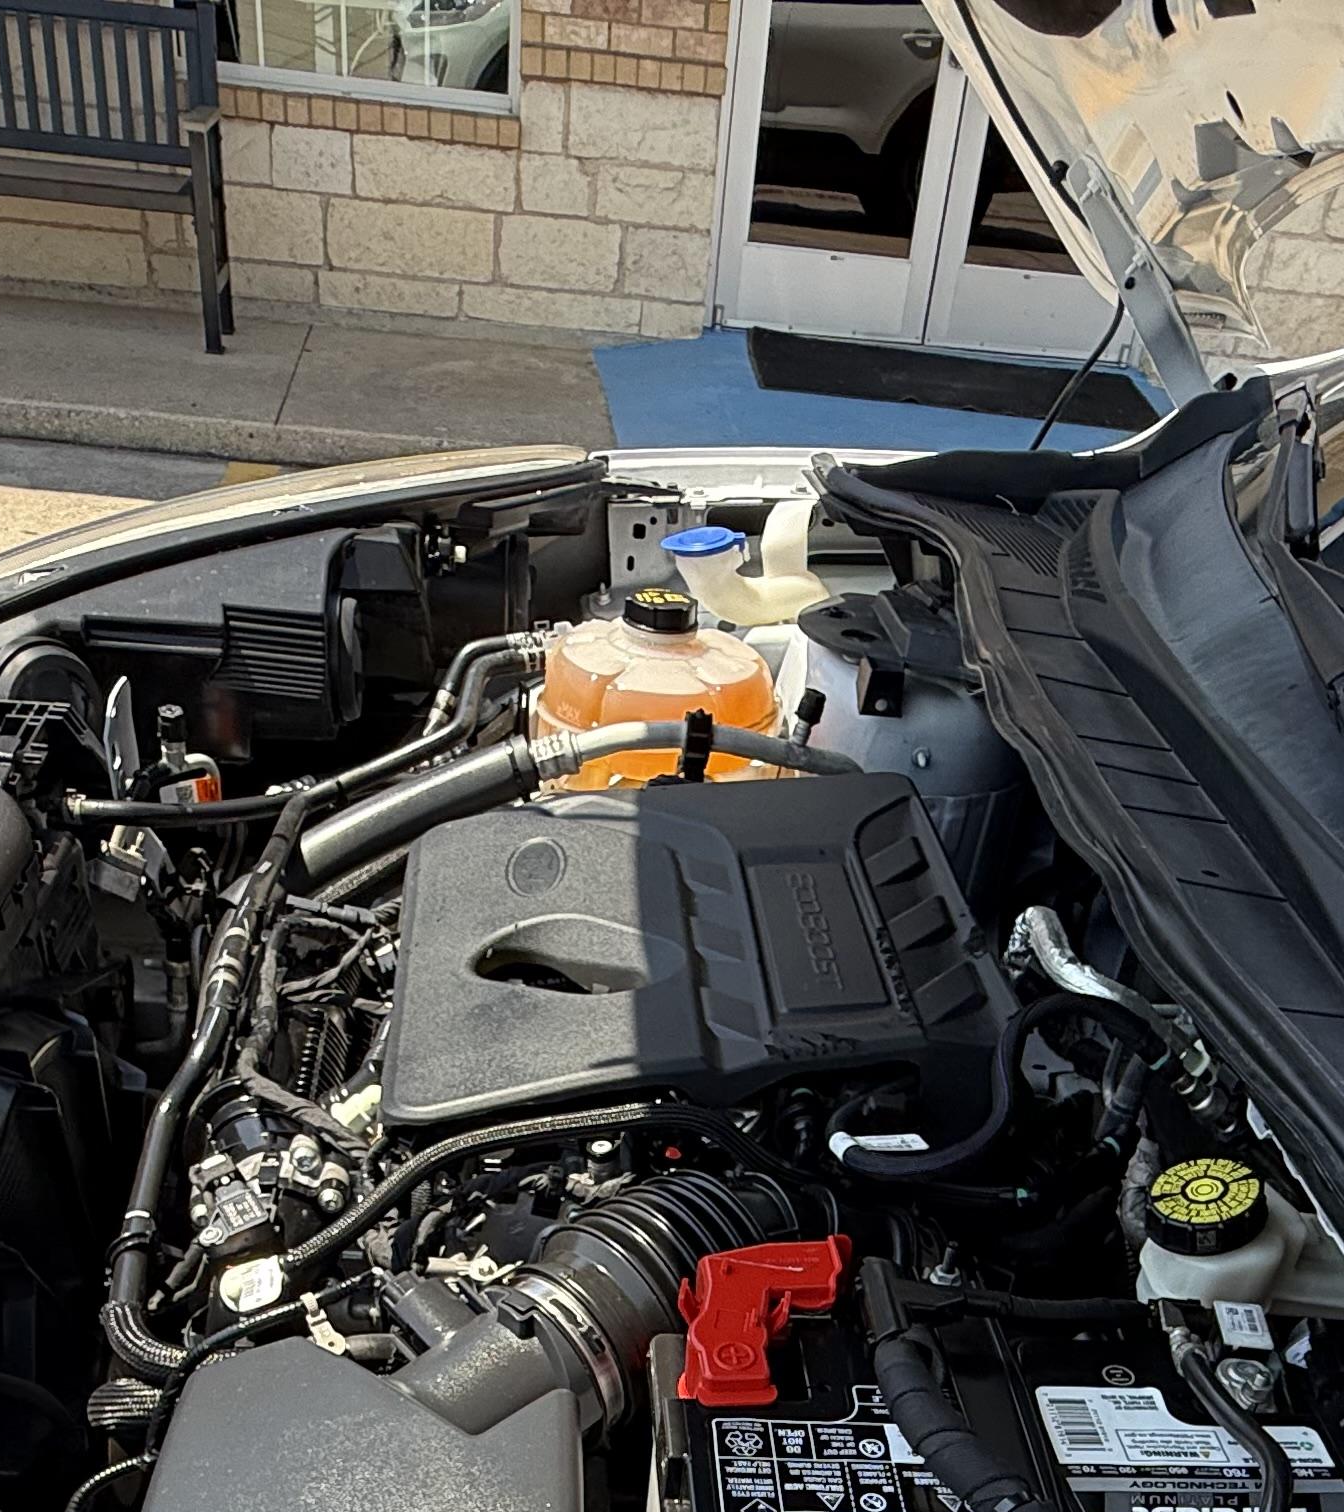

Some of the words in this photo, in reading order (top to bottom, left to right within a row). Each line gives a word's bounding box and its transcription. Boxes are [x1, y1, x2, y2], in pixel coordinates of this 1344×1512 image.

[774, 1428, 805, 1437] OPEN.
[781, 1437, 804, 1445] NOT
[785, 1445, 802, 1454] DO
[839, 1448, 857, 1456] KEEP
[1139, 1449, 1199, 1459] WARNING:
[1082, 1465, 1096, 1474] 70
[1222, 1467, 1250, 1478] 760
[1128, 1480, 1250, 1490] TECHNOLOGY
[1130, 1494, 1238, 1506] PLATINUM
